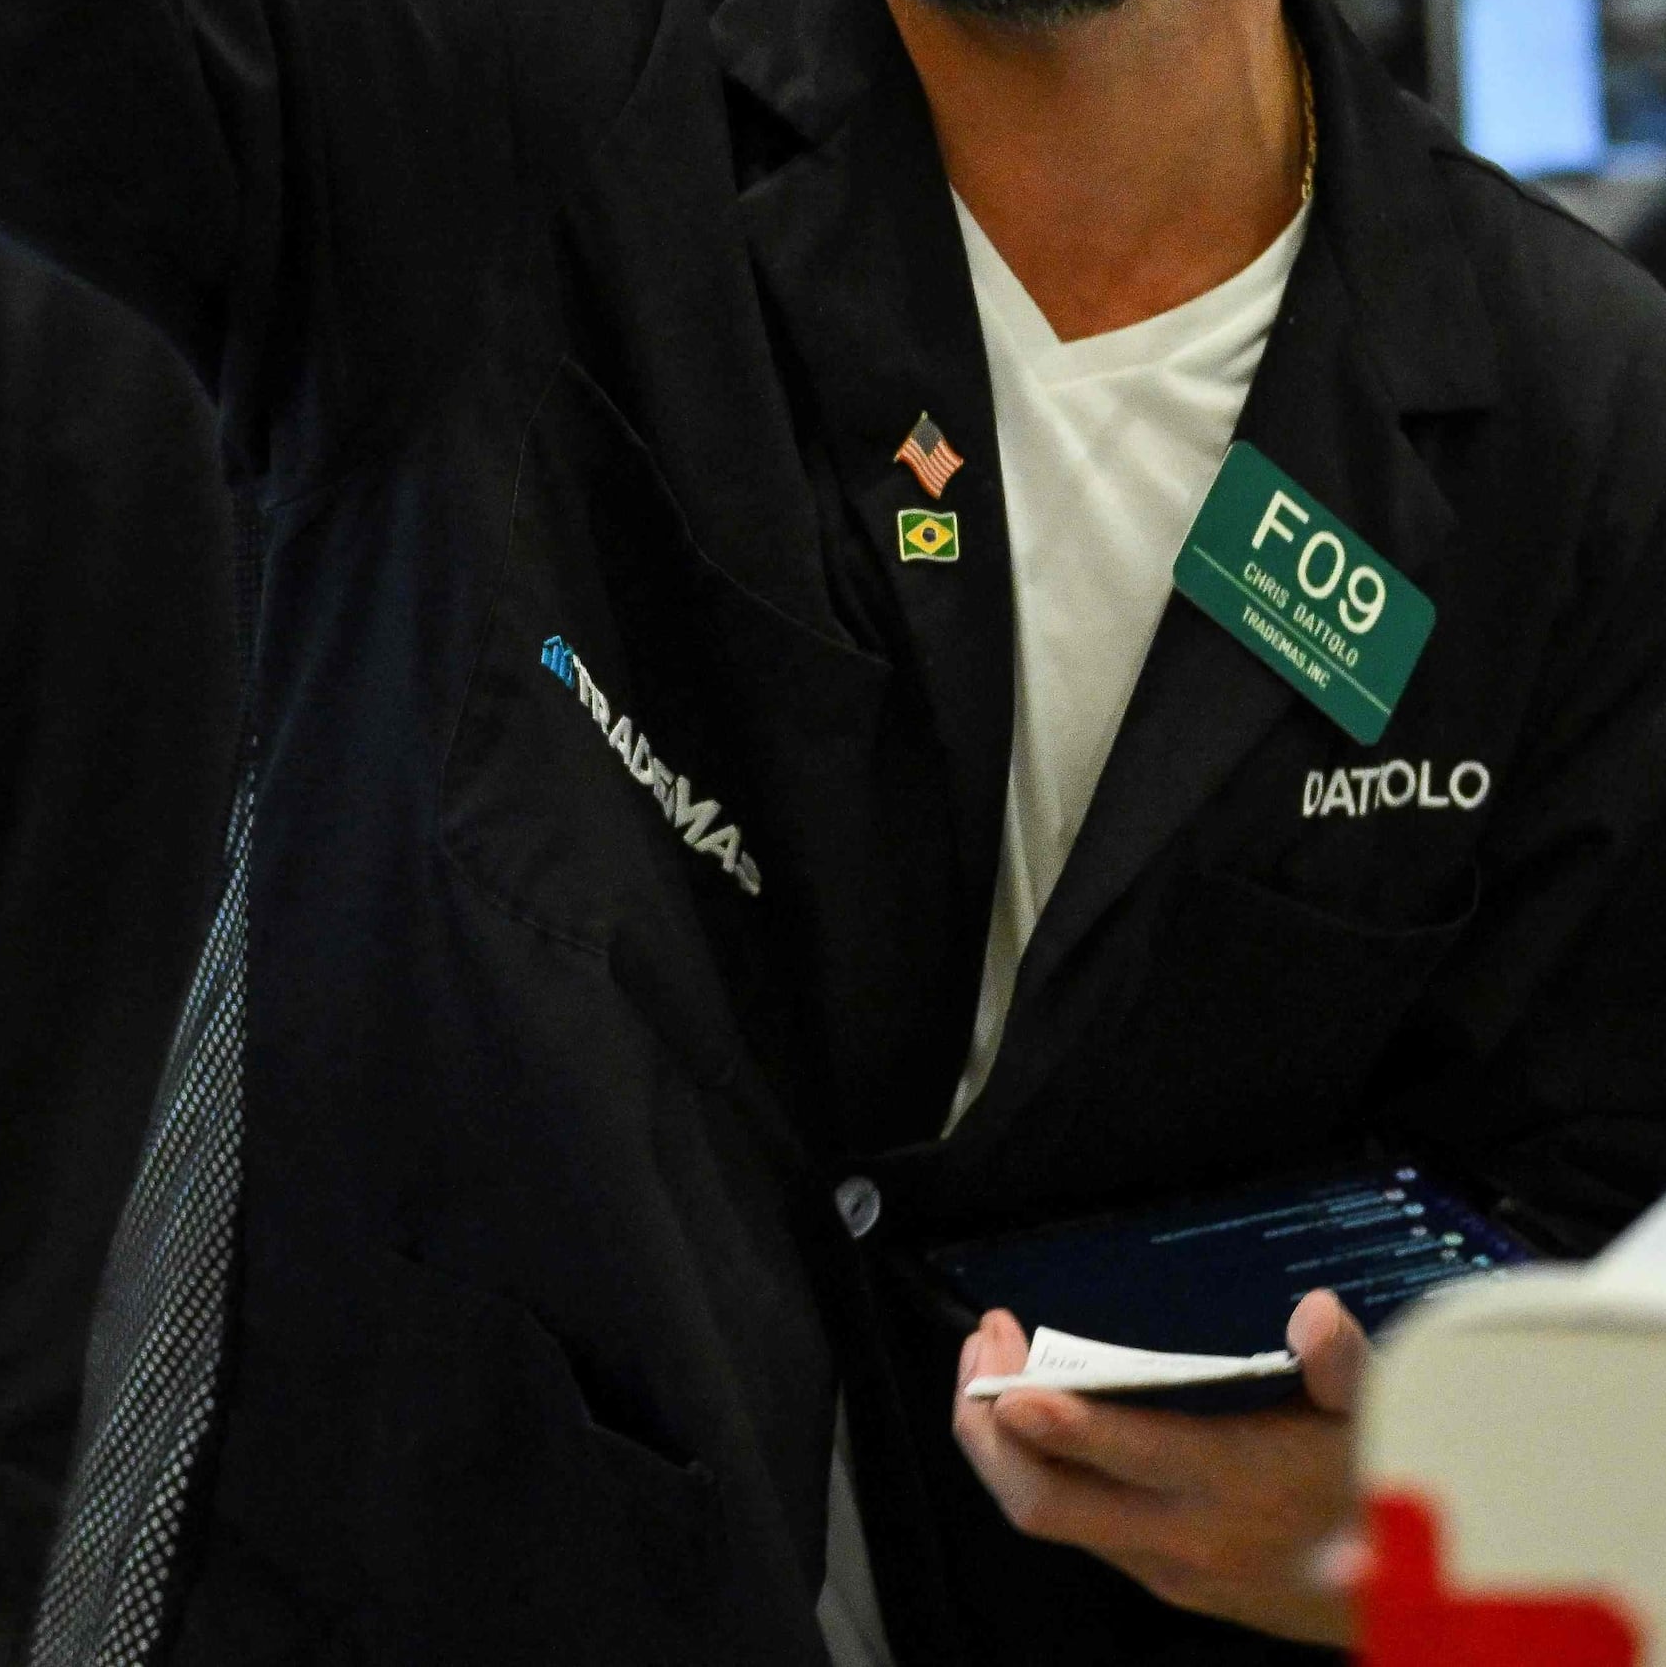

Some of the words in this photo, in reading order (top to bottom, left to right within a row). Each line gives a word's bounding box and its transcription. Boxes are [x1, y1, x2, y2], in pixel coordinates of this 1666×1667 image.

[1243, 560, 1291, 610] CHRIS
[1292, 602, 1360, 669] DATTOLO
[1251, 489, 1387, 634] F09
